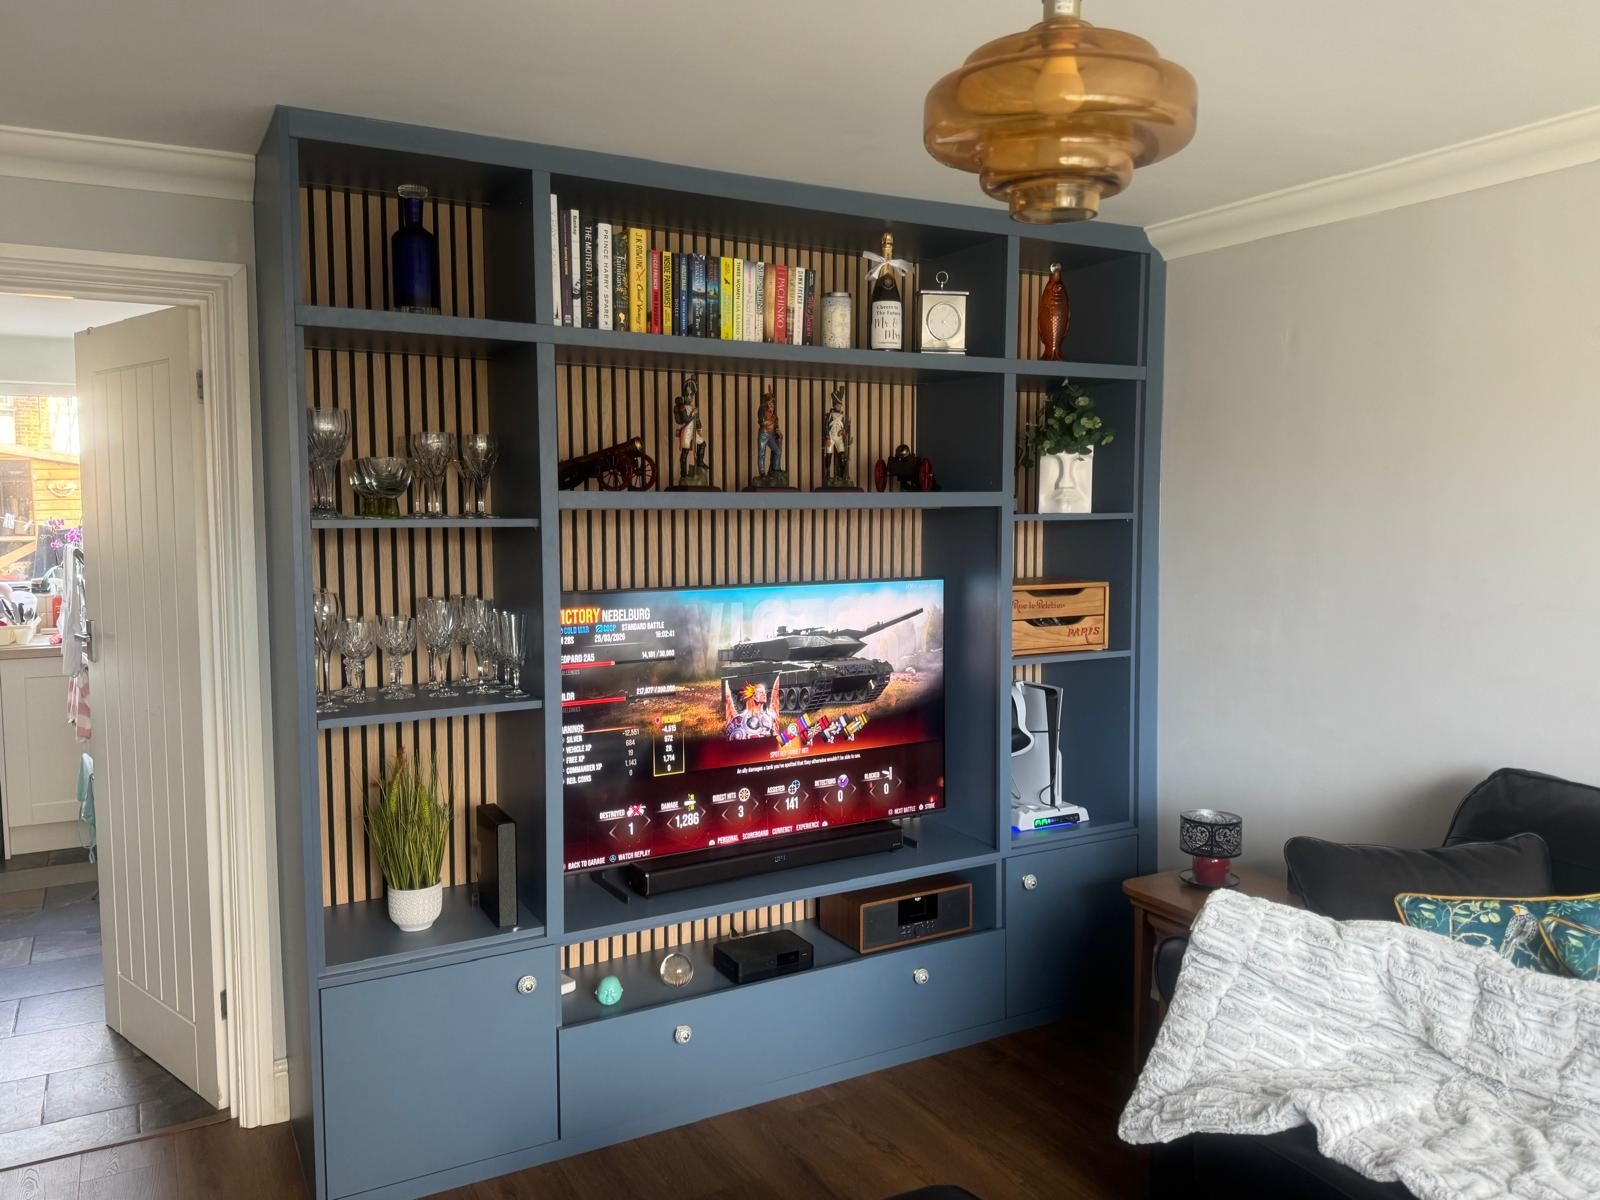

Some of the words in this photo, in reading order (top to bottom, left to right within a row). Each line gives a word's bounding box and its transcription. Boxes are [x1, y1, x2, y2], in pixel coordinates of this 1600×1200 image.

[585, 242, 593, 272] MOTHER
[585, 291, 593, 319] LOGAN
[776, 280, 784, 328] PACHINKO
[560, 608, 600, 624] ICTORY
[602, 608, 650, 622] NEBELBURG
[622, 623, 646, 631] STANDARD
[647, 621, 665, 629] BATTLE
[1067, 626, 1100, 644] PARIS
[561, 655, 583, 663] EOPARD
[566, 735, 582, 743] SILVER
[566, 745, 585, 754] VEHICLE
[566, 756, 578, 764] FREE
[566, 764, 596, 774] COMMANDER
[883, 783, 889, 795] 0
[712, 794, 726, 803] DIRECT
[837, 790, 843, 802] 0
[661, 801, 679, 810] DAMAGE
[785, 796, 798, 810] 141
[903, 805, 916, 813] BATTLE
[600, 809, 625, 820] DESTROYED
[738, 805, 744, 818] 3
[675, 812, 700, 829] 1,286
[628, 822, 634, 835] 1
[618, 851, 633, 861] WATCH
[634, 849, 651, 858] REPLAY
[568, 861, 580, 870] BACK
[587, 857, 606, 867] GARAGE
